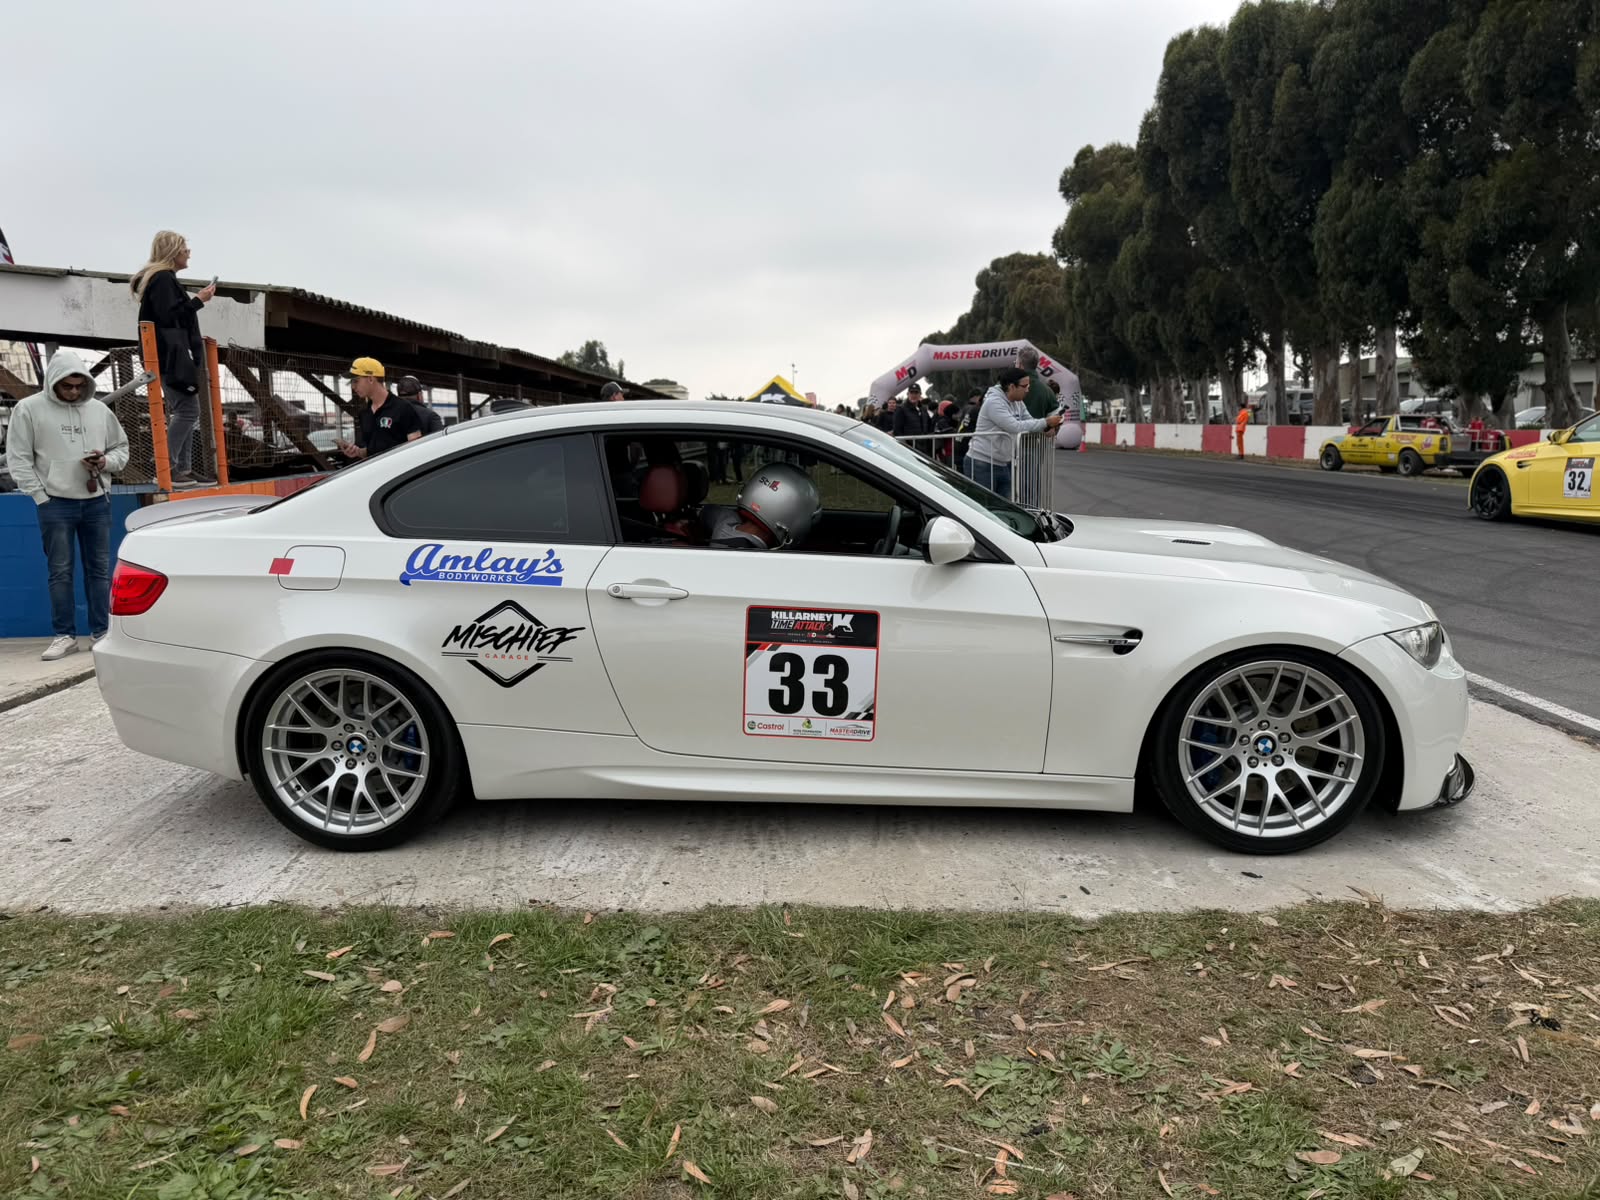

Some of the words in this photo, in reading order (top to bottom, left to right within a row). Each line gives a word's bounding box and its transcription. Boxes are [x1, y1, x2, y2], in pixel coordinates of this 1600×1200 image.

[933, 347, 1018, 361] MASTERDRIVE
[895, 366, 917, 381] MD
[1567, 470, 1586, 491] 32
[404, 543, 565, 583] Amlay's
[438, 571, 513, 583] BODYWORKS
[771, 611, 833, 621] KILLARNEY
[770, 619, 795, 629] TIME
[793, 620, 827, 631] ATTACK
[441, 623, 586, 654] MISCHIEF
[485, 653, 530, 661] GARAGE
[768, 652, 850, 717] 33
[757, 722, 784, 731] Castrol
[830, 727, 871, 735] MASTERDRIVE
